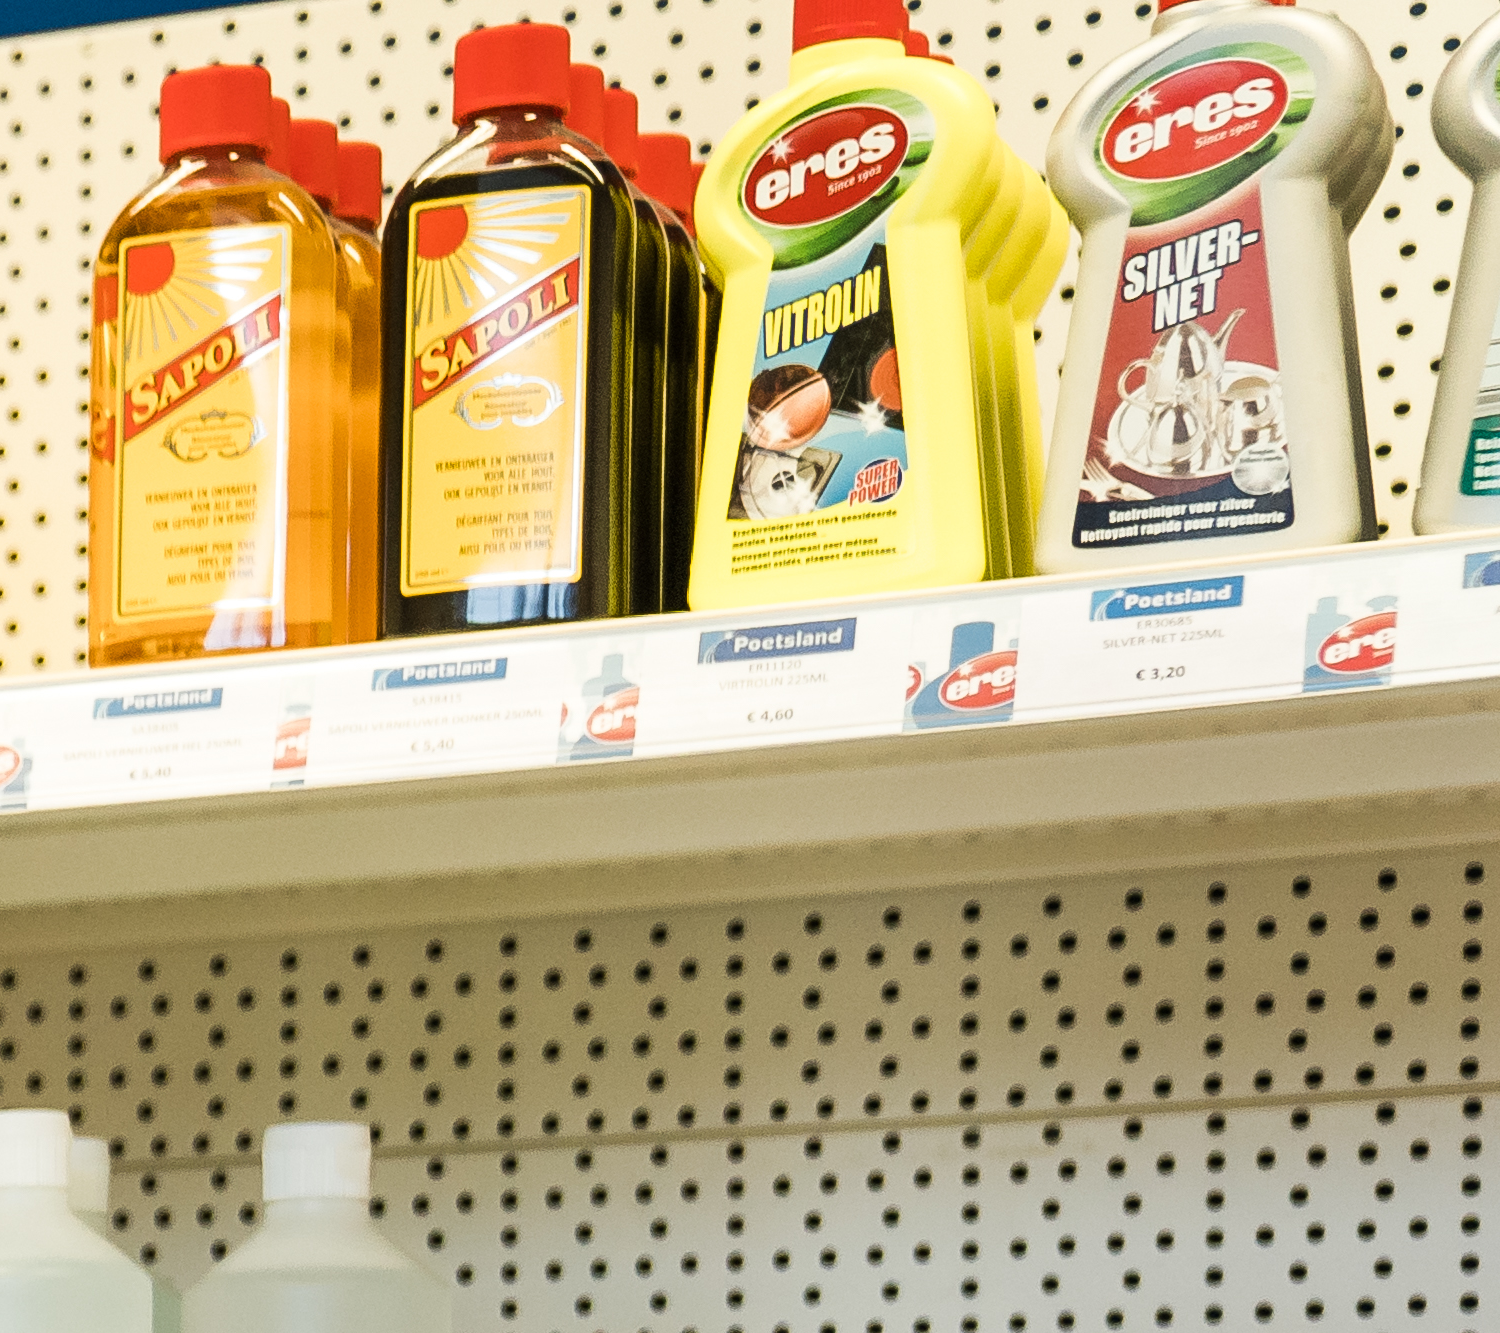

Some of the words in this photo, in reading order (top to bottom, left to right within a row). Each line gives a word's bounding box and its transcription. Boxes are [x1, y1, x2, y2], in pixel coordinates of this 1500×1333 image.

[1114, 77, 1275, 162] eres
[1195, 129, 1227, 150] Since
[1229, 120, 1259, 138] 1902
[755, 122, 896, 210] eres
[827, 176, 856, 196] Since
[858, 164, 882, 182] 1902
[1122, 220, 1259, 302] SILVER-
[764, 265, 882, 357] VITROLIN
[1152, 269, 1223, 332] NET
[421, 272, 571, 391] SAPOLI
[130, 306, 272, 426] SAPOLI
[435, 456, 487, 472] VERNIEUWER
[490, 456, 501, 467] EN
[484, 469, 504, 481] VOOR
[856, 458, 898, 489] SUPER
[508, 484, 519, 495] EN
[849, 481, 898, 506] POWER
[1108, 503, 1187, 524] Snelreiniger
[1189, 500, 1219, 517] voor
[1220, 497, 1256, 513] zilver
[1080, 523, 1137, 543] Nettoyant
[1139, 517, 1182, 536] rapide
[1183, 515, 1214, 532] pour
[1216, 510, 1286, 529] argenterie
[1124, 585, 1232, 610] Poetsland
[734, 628, 843, 653] Poetsland
[1102, 633, 1177, 649] SILVER-NET
[1180, 627, 1225, 643] 225ML
[403, 661, 495, 683] Poetsland
[719, 674, 783, 691] VIRTROLIN
[787, 673, 828, 684] 225ML
[1136, 669, 1146, 681] €
[1151, 666, 1186, 680] 3,20
[122, 687, 212, 712] Poetsland
[747, 711, 757, 722] €
[761, 709, 793, 723] 4,60
[423, 737, 455, 752] 5,40
